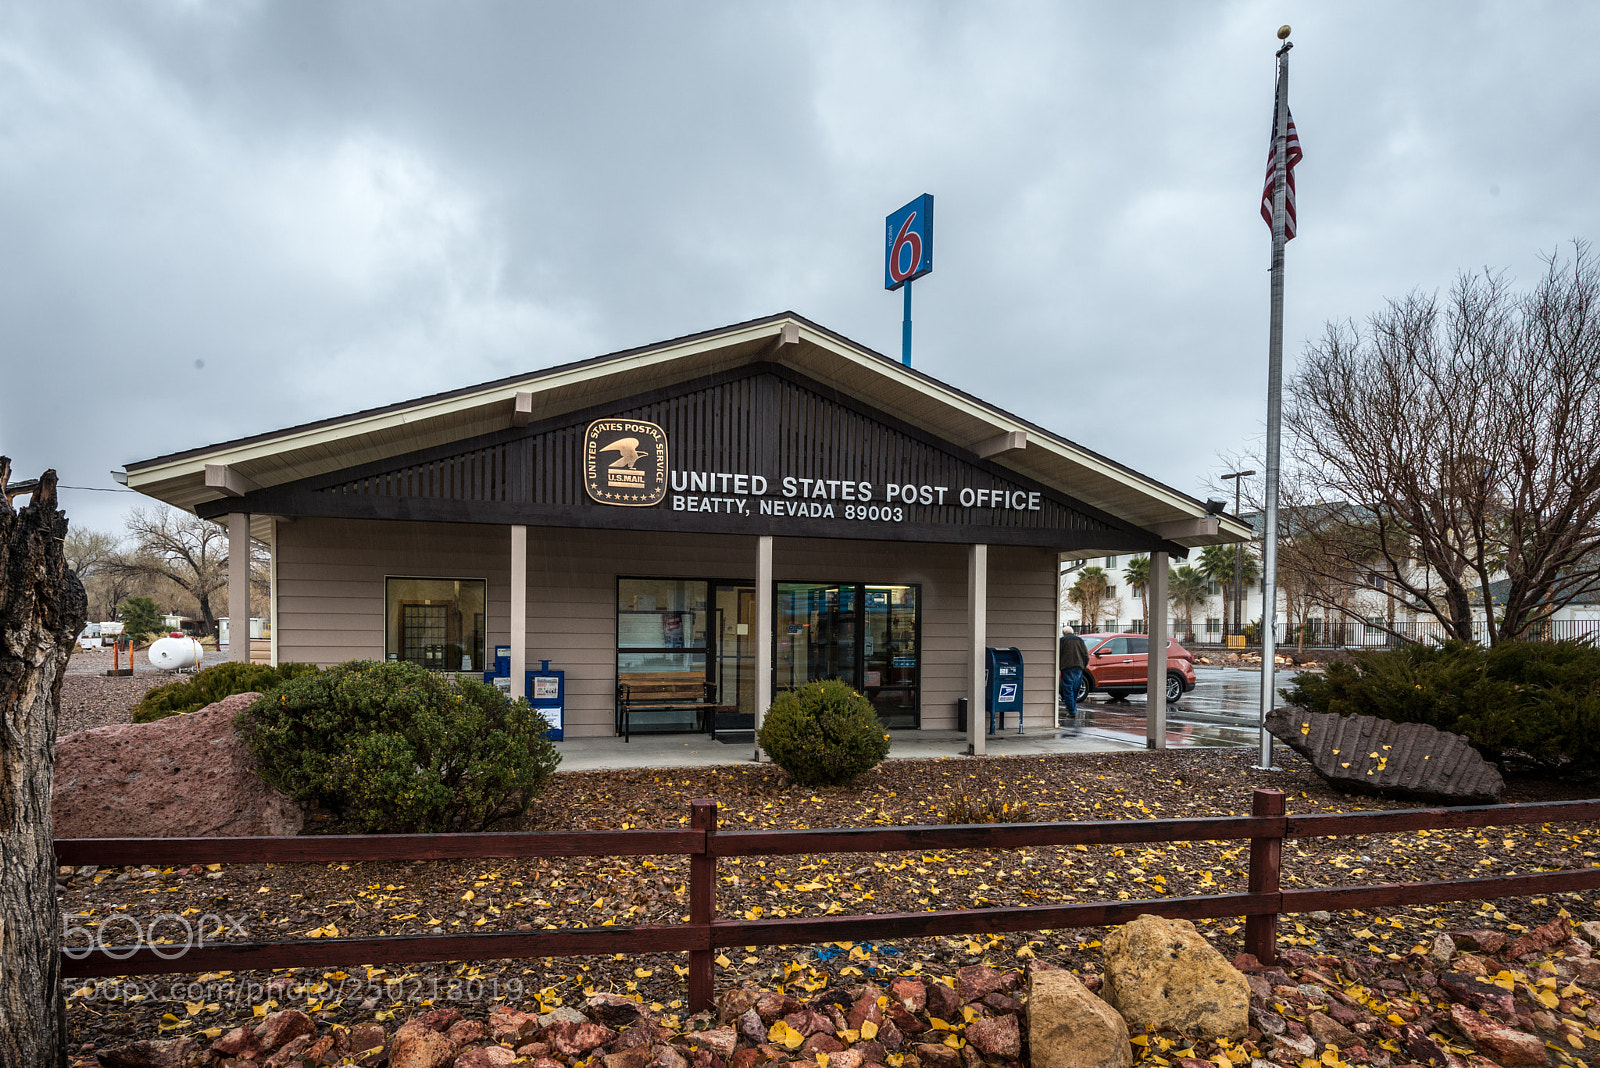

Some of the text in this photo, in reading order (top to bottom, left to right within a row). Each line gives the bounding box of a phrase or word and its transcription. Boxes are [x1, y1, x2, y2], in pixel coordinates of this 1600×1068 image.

[889, 211, 922, 283] 6
[588, 423, 664, 484] UNITED STATES POSTAL SERVICE
[671, 470, 1041, 511] UNITED STATES POST OFFICE
[672, 495, 903, 522] BEATTY, NEVADA 89003
